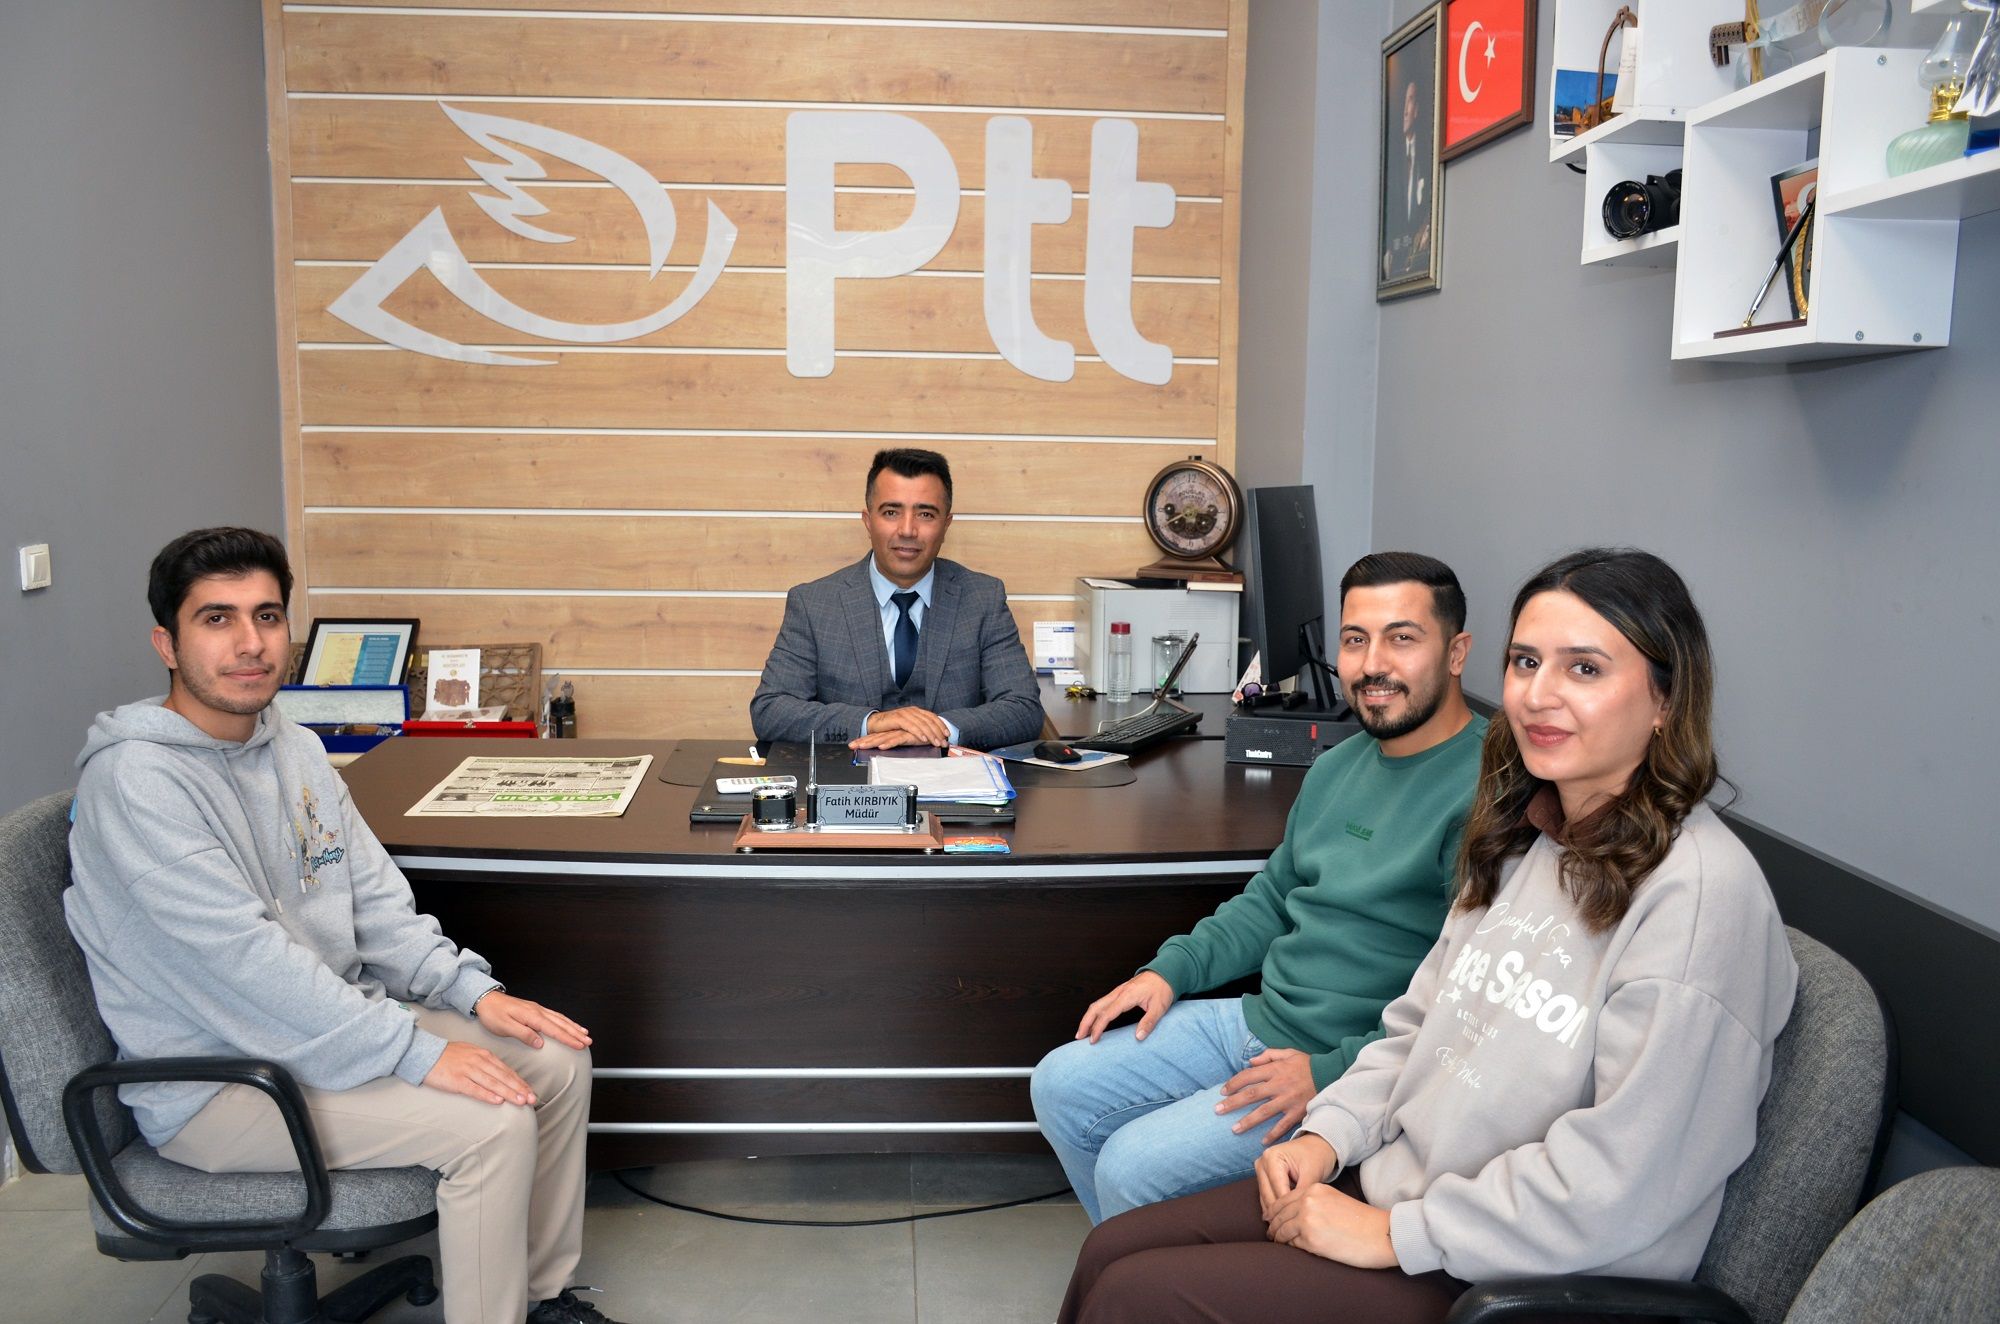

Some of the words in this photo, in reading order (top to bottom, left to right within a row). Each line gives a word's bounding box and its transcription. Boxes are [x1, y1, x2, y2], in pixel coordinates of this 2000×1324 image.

[786, 110, 1176, 385] Ptt
[825, 796, 851, 806] Fatih
[854, 796, 898, 806] KIRBIYIK
[845, 809, 880, 819] Müdür
